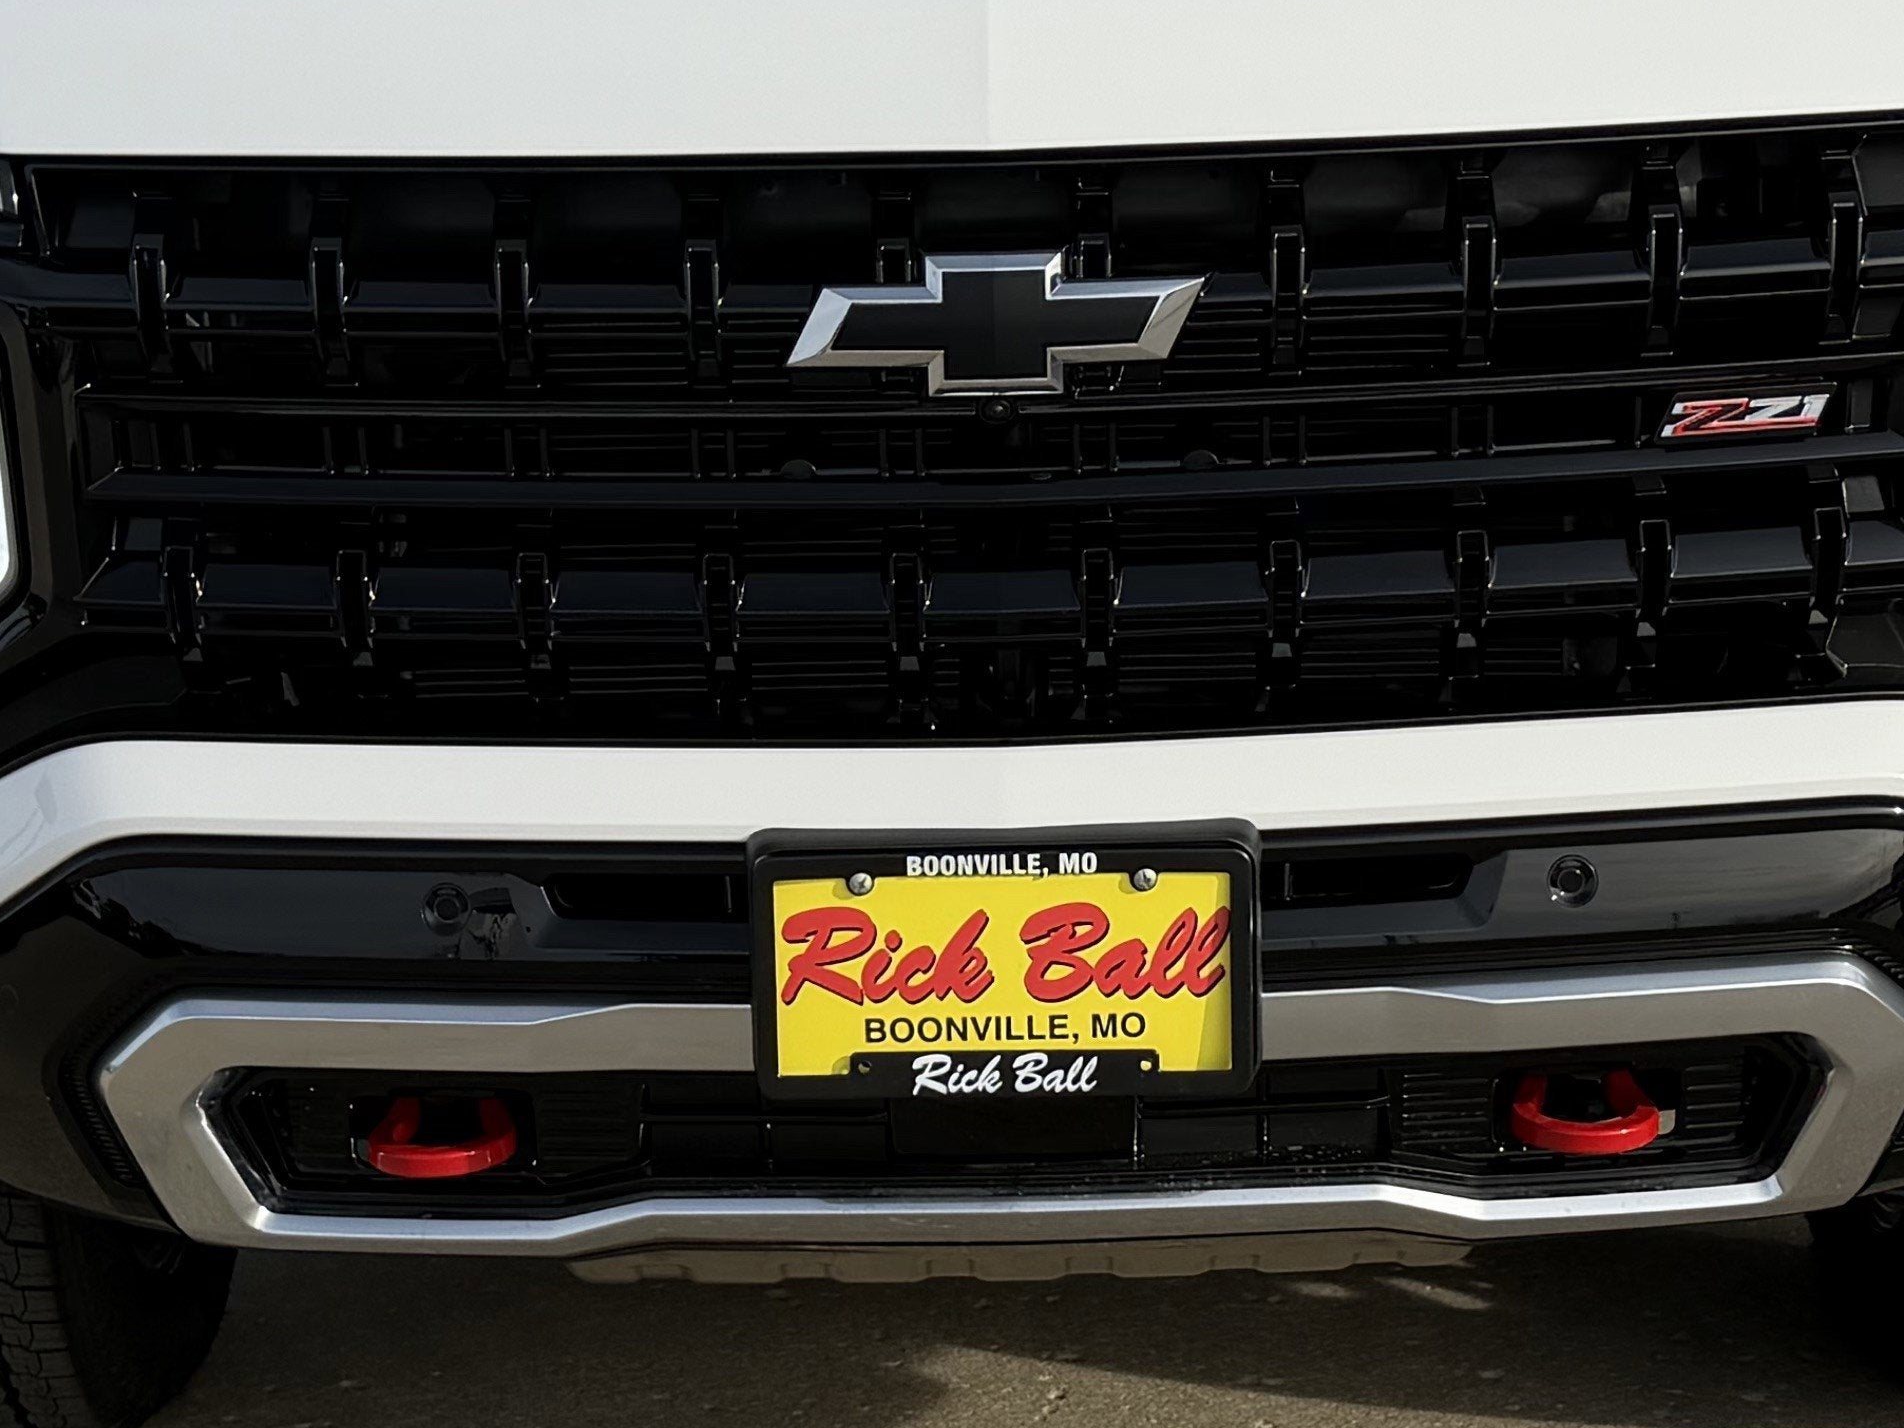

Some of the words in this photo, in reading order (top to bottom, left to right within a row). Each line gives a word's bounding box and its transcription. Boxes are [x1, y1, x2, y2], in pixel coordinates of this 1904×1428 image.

[1660, 393, 1830, 438] Z71
[906, 854, 1049, 877] BOONVILLE,
[1058, 852, 1097, 874] MO
[781, 906, 995, 1006] Rick
[1020, 902, 1232, 1002] Ball
[864, 1015, 1079, 1044] BOONVILLE,
[1091, 1012, 1146, 1038] MO
[912, 1053, 1002, 1096] Rick
[1013, 1054, 1098, 1094] Ball
